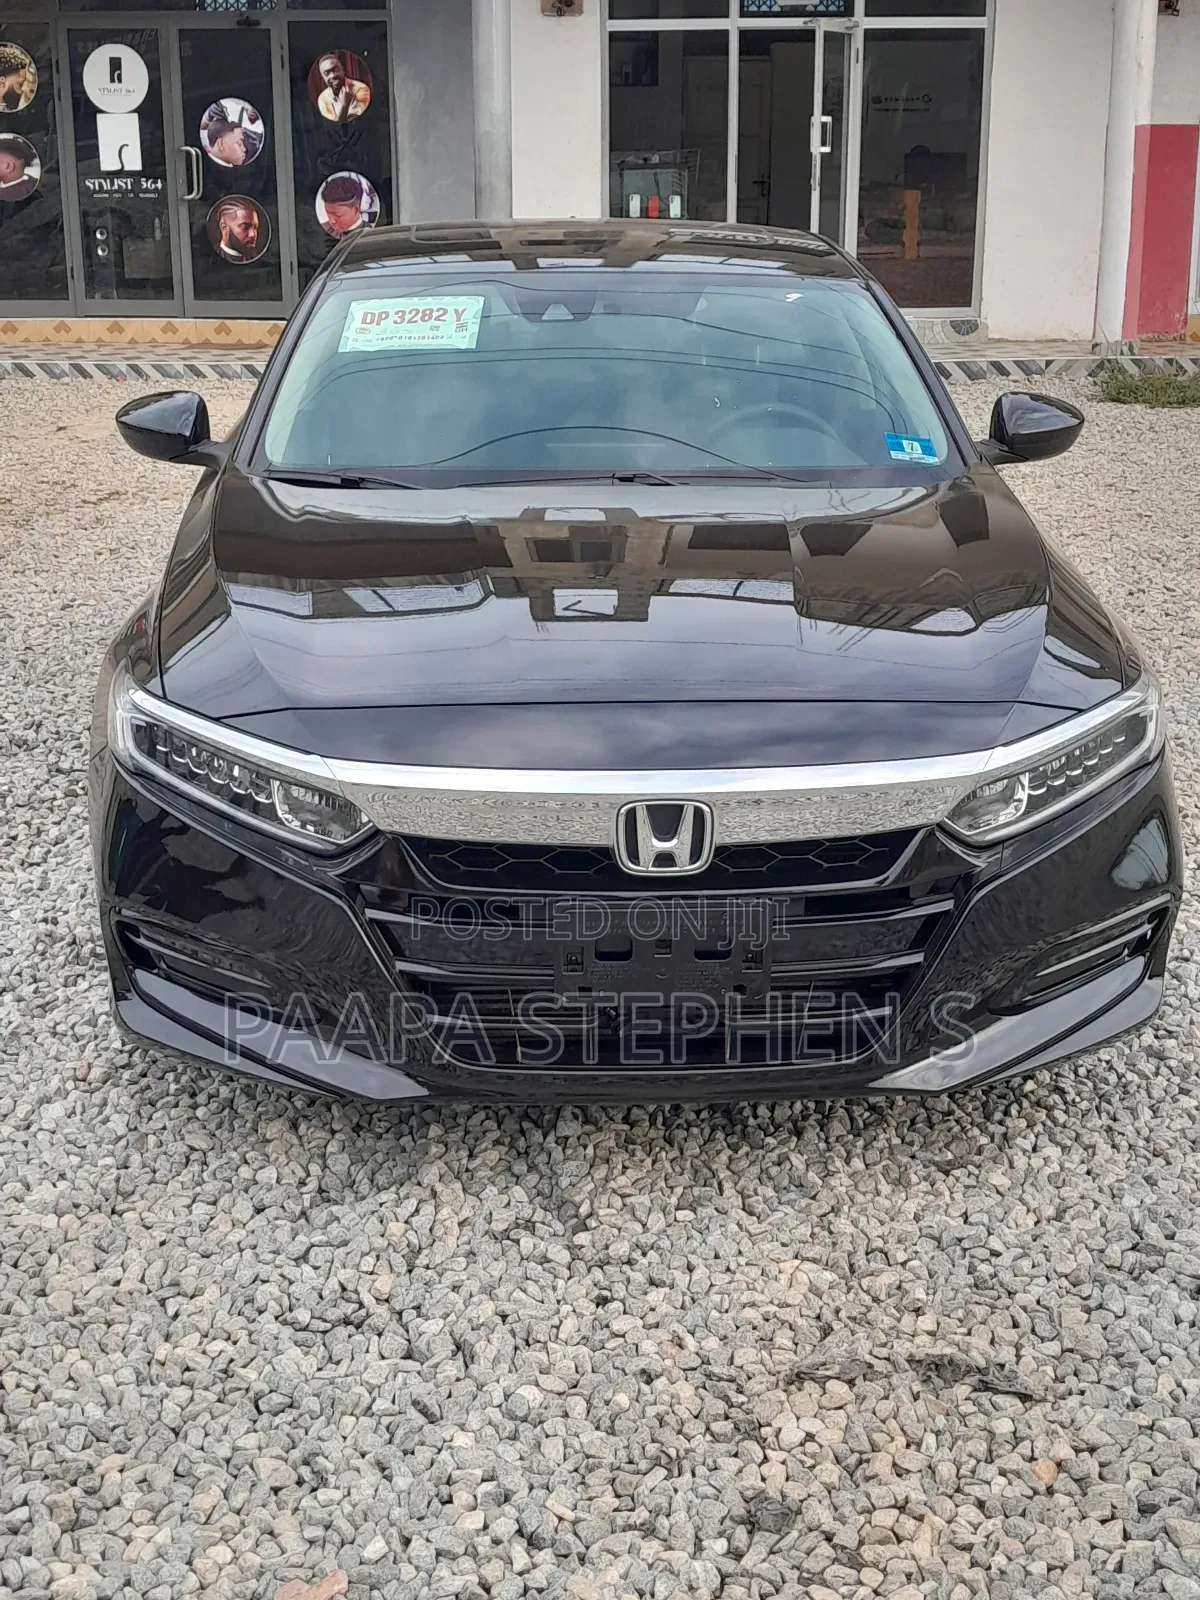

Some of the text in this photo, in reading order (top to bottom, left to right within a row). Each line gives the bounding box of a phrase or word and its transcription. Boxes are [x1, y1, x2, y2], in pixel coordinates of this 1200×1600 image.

[85, 178, 134, 190] STYLIST
[361, 307, 468, 326] DP 3282 Y
